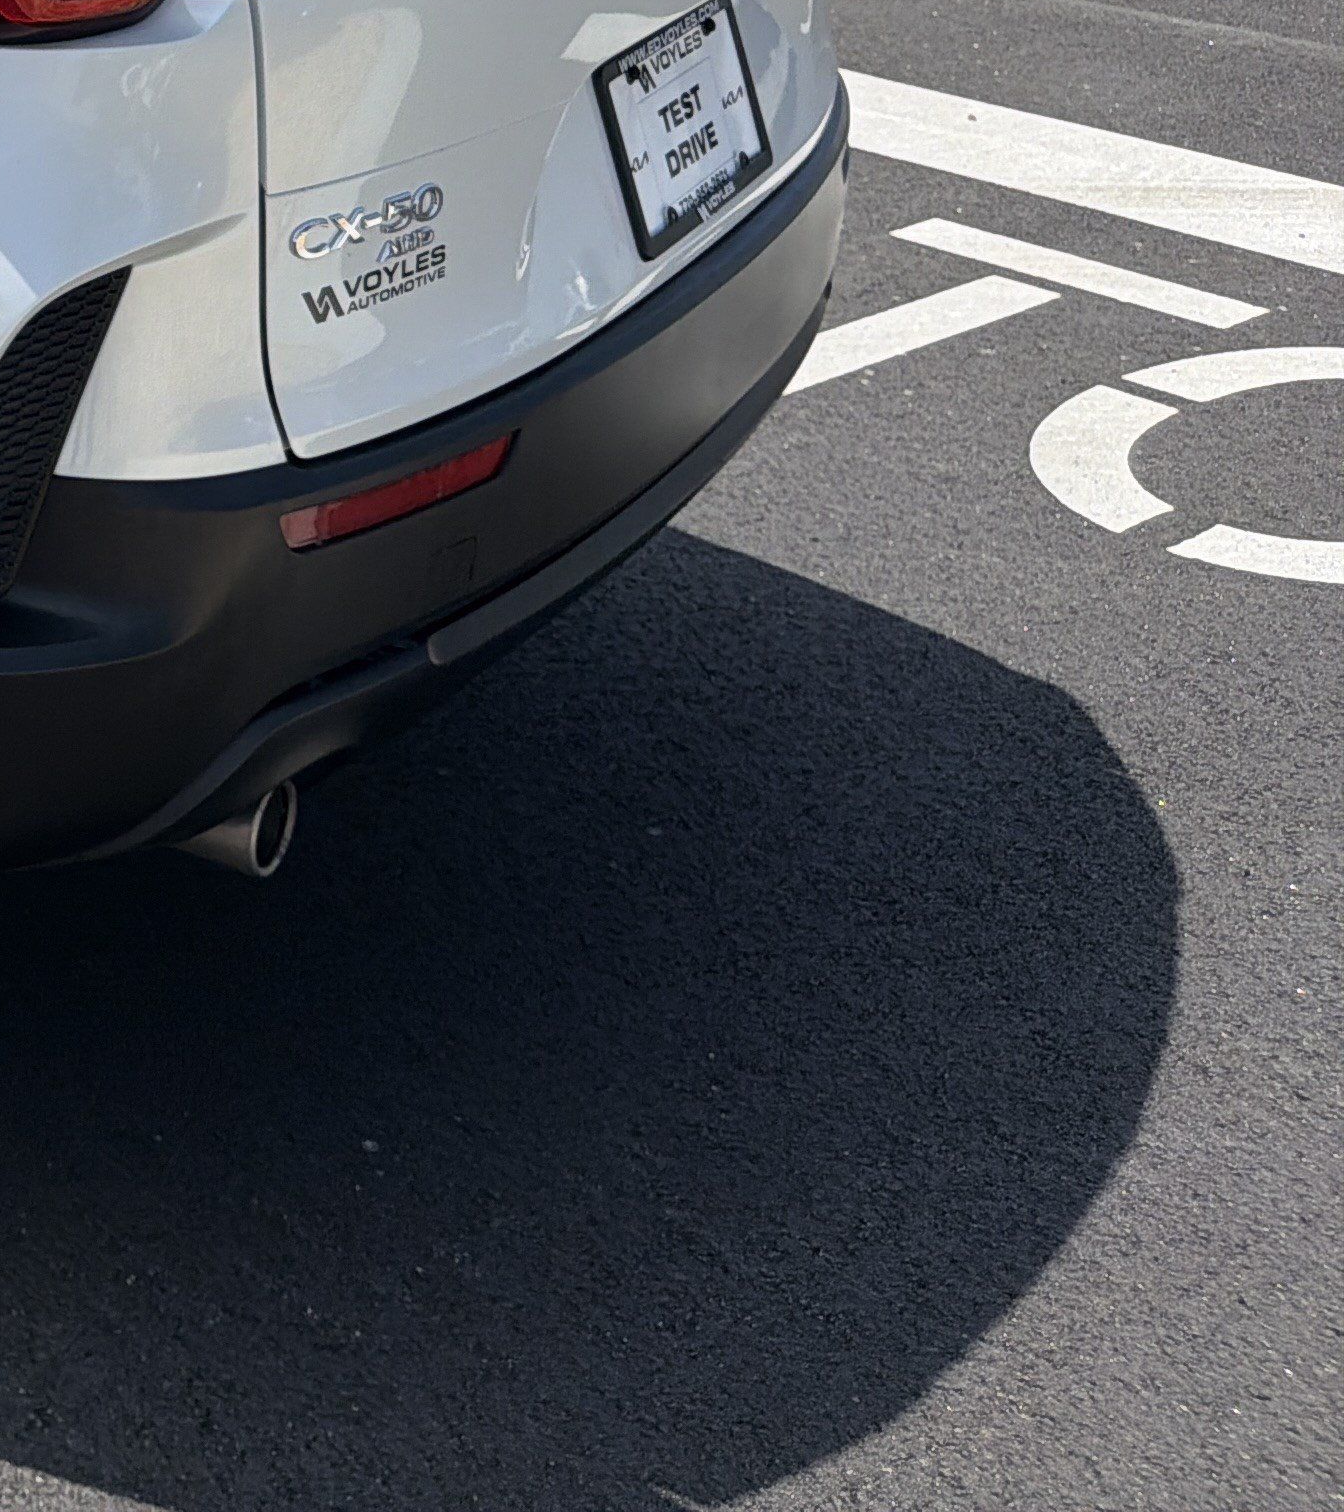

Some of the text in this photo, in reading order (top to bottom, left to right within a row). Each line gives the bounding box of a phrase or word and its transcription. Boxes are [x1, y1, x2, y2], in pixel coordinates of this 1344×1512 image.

[650, 30, 703, 75] VOYLES
[658, 84, 701, 133] TEST
[665, 121, 719, 179] DRIVE
[288, 182, 444, 260] CX-50
[343, 244, 446, 298] VOYLES
[347, 266, 446, 315] AUTOMOTIVE
